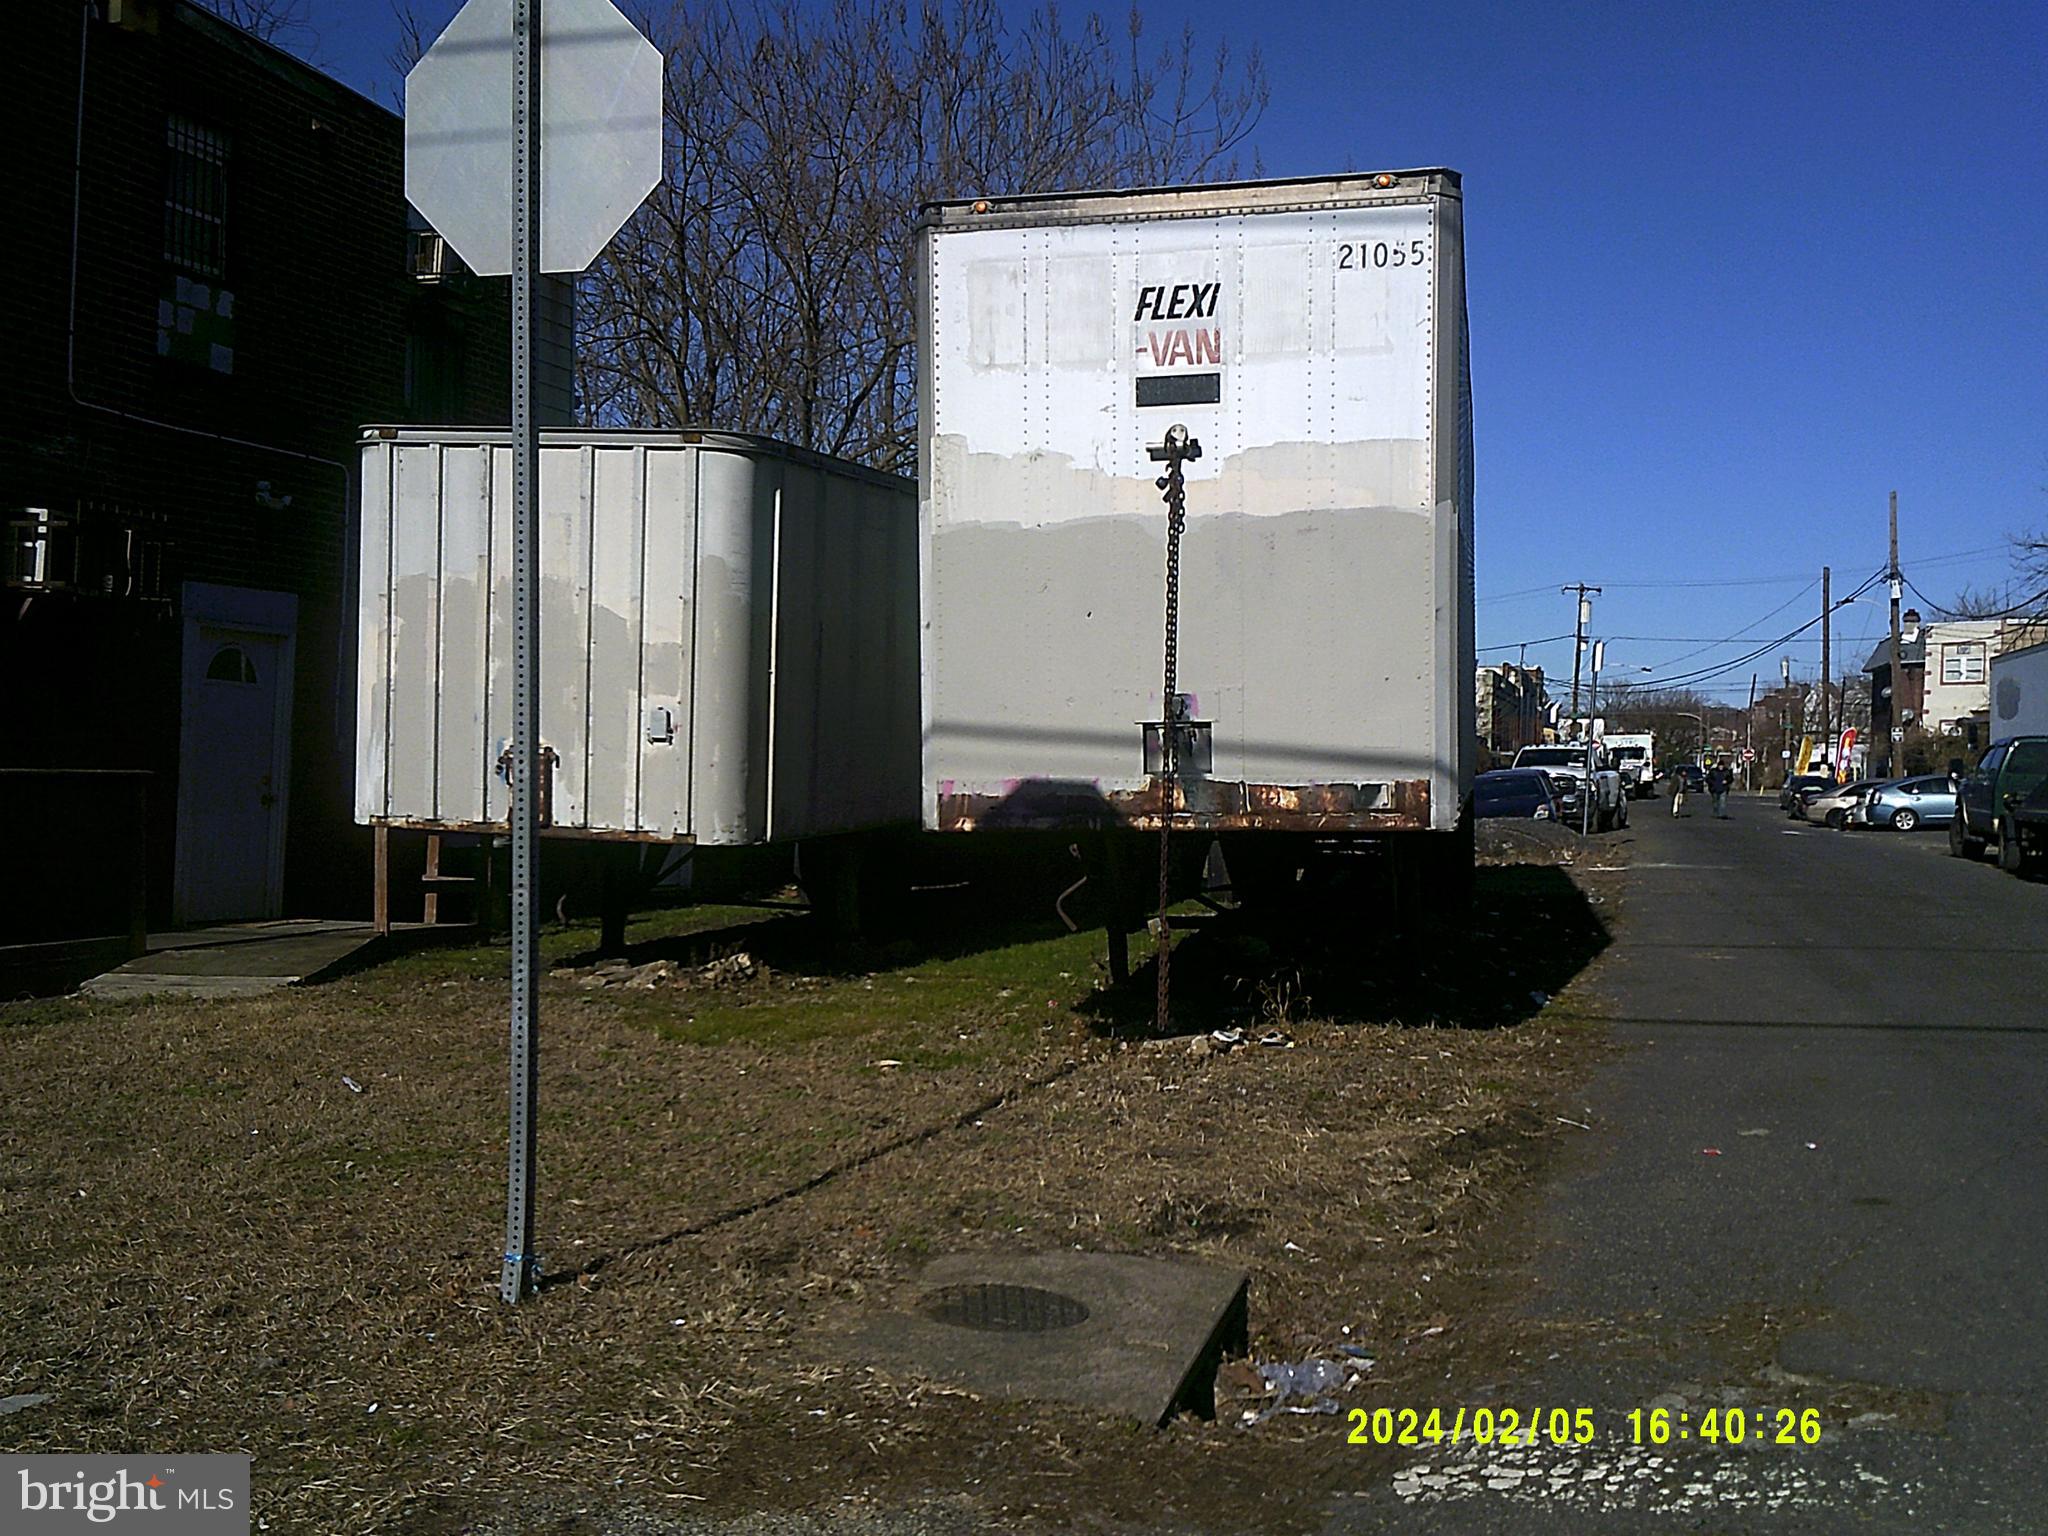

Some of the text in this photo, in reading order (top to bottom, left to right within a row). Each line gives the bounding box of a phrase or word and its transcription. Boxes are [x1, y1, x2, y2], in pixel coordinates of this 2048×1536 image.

[1339, 240, 1425, 269] 21055
[1133, 282, 1222, 322] FLEXI
[1135, 327, 1221, 367] -VAN
